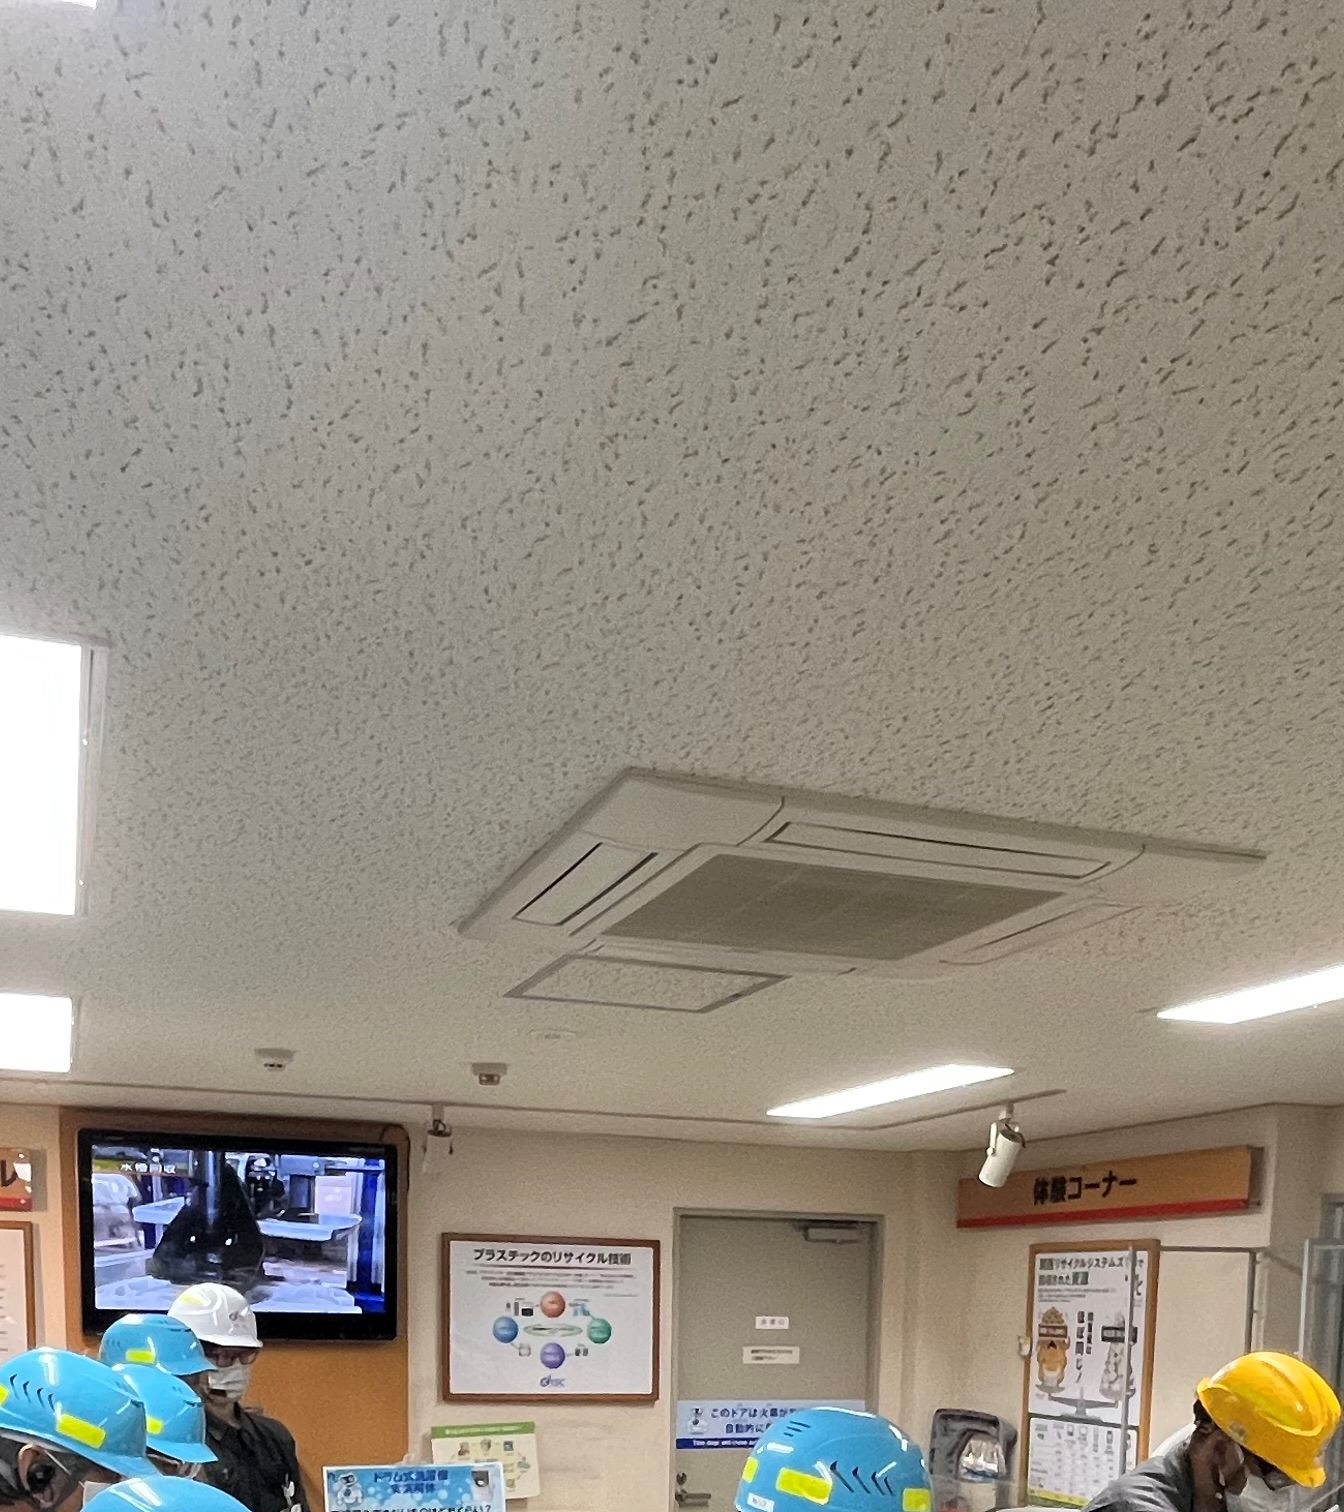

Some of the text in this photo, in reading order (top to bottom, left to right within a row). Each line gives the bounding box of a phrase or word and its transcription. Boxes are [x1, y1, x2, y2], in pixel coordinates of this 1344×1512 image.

[1033, 1170, 1137, 1206] 体験コーナー
[473, 1248, 632, 1266] プラスチックのリサイクル技術
